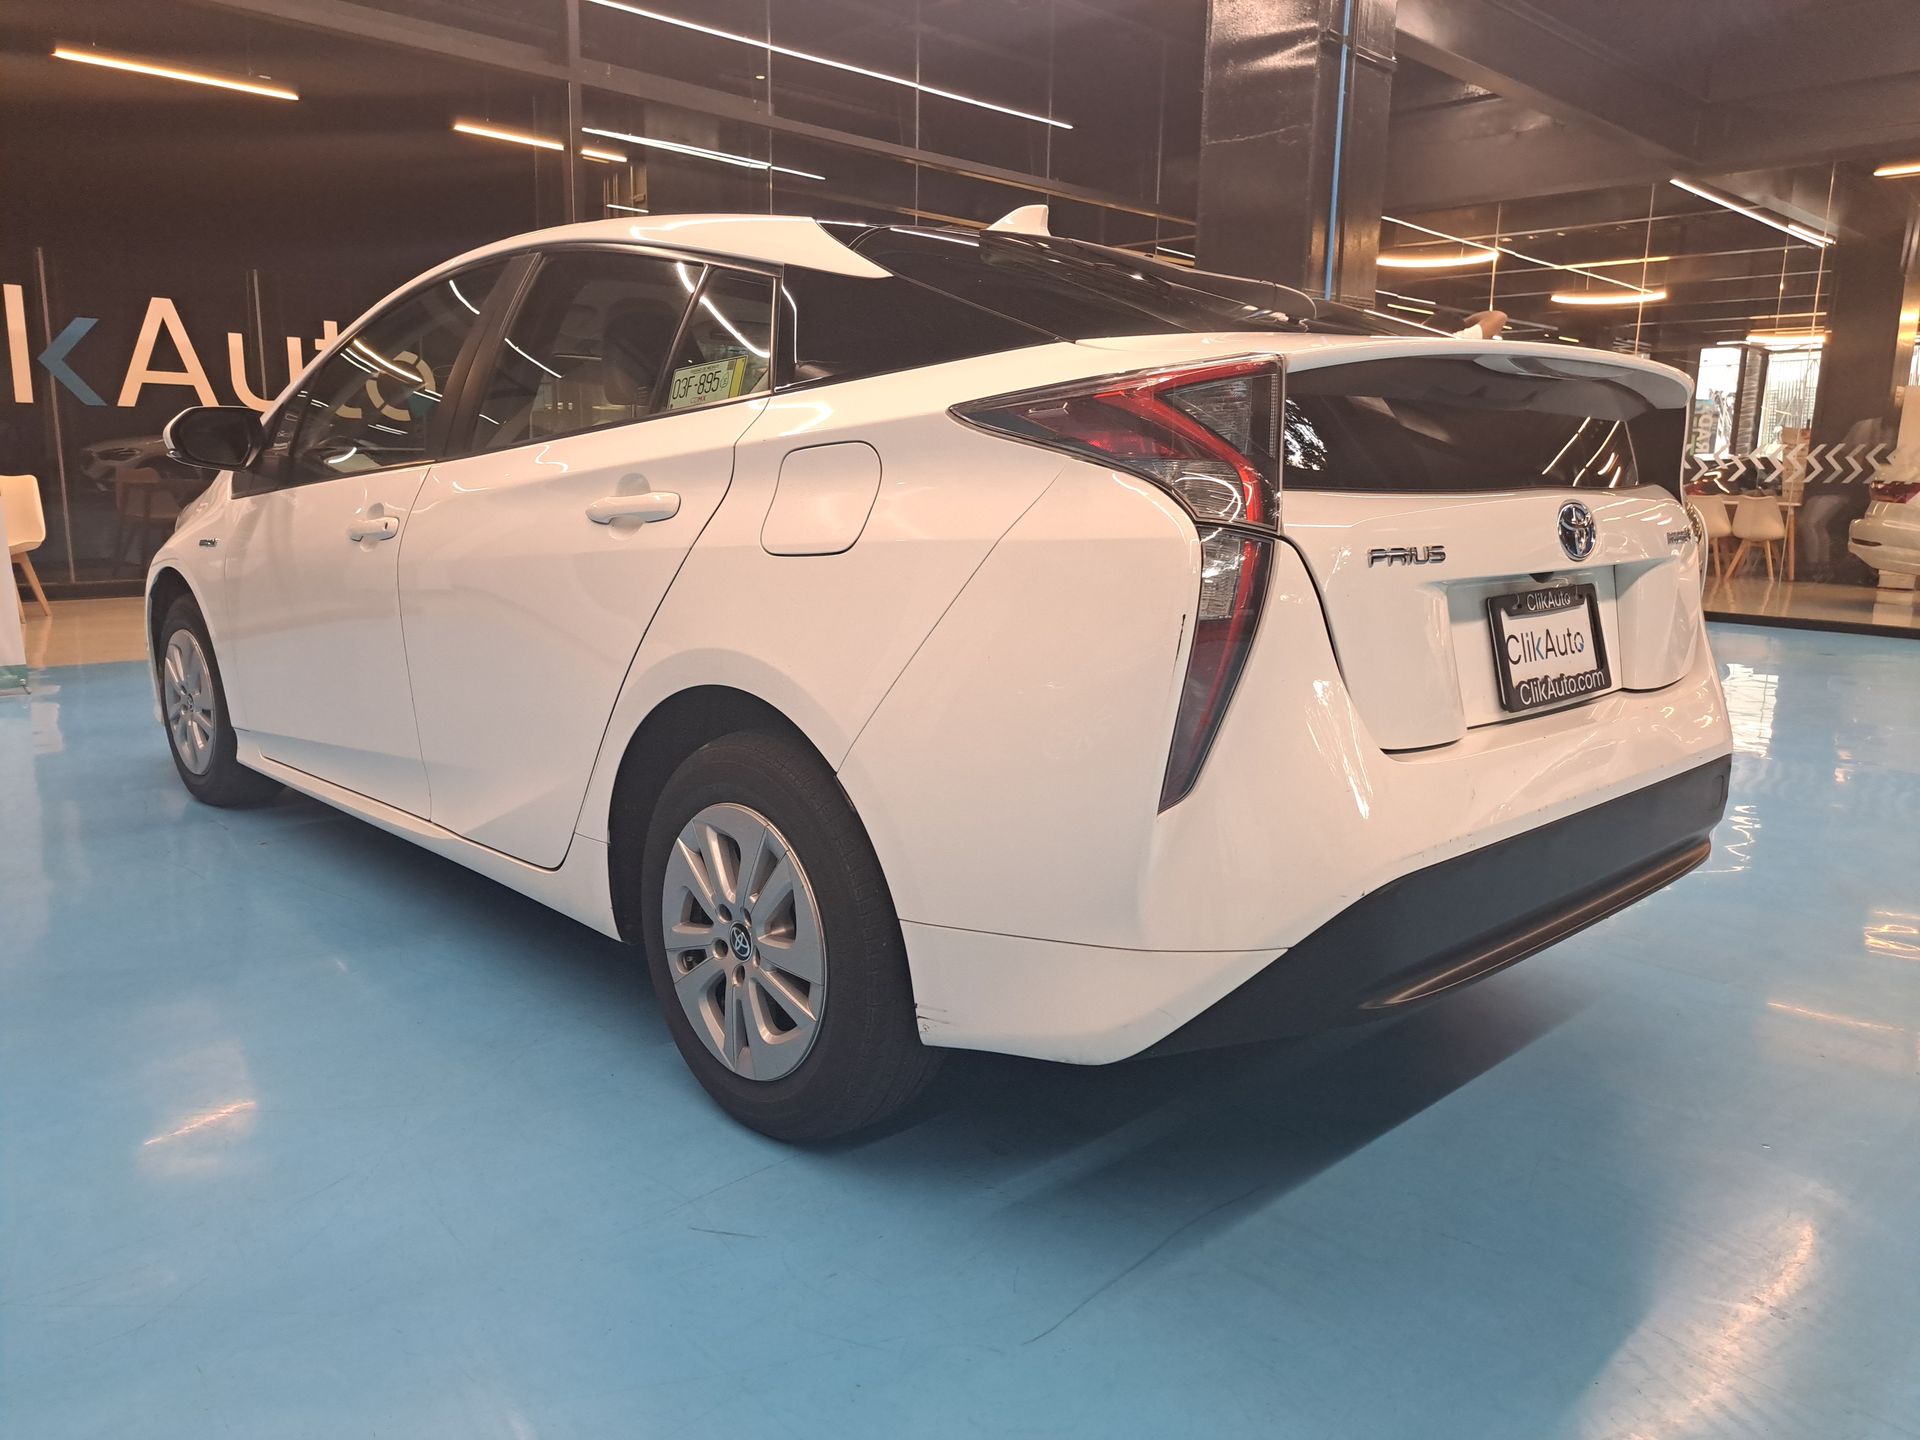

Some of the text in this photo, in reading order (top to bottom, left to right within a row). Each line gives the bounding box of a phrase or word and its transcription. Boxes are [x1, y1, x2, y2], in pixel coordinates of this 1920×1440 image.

[672, 370, 721, 400] 03F-895
[1367, 545, 1446, 568] PRIUS
[1526, 591, 1571, 611] ClikAuto
[1506, 627, 1585, 665] ClikAuto
[1519, 670, 1605, 705] ClikAuto.com
